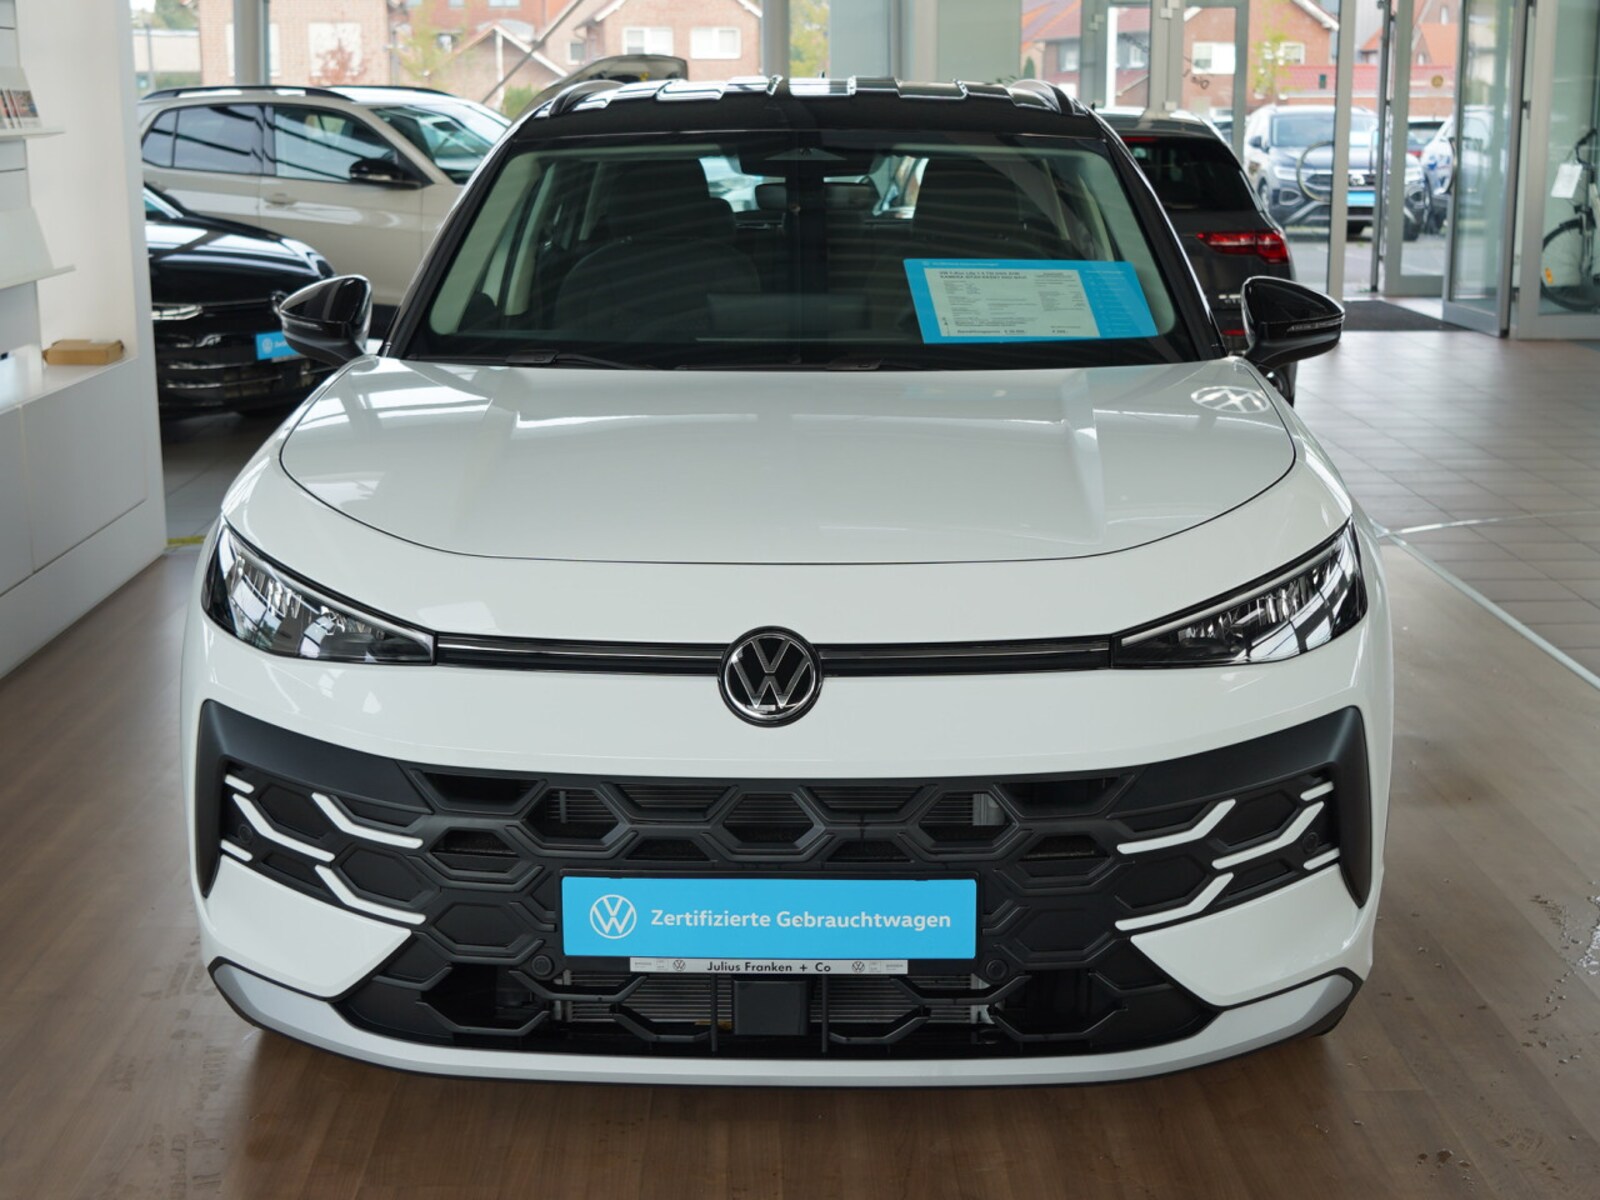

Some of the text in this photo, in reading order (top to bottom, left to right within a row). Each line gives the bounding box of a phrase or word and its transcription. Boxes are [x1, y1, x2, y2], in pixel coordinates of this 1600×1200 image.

[725, 633, 816, 719] VW
[590, 894, 951, 940] VW Zertifizierte Gebrauchtwagen
[707, 961, 741, 972] Julius
[744, 962, 793, 972] Franken
[815, 962, 831, 972] Co
